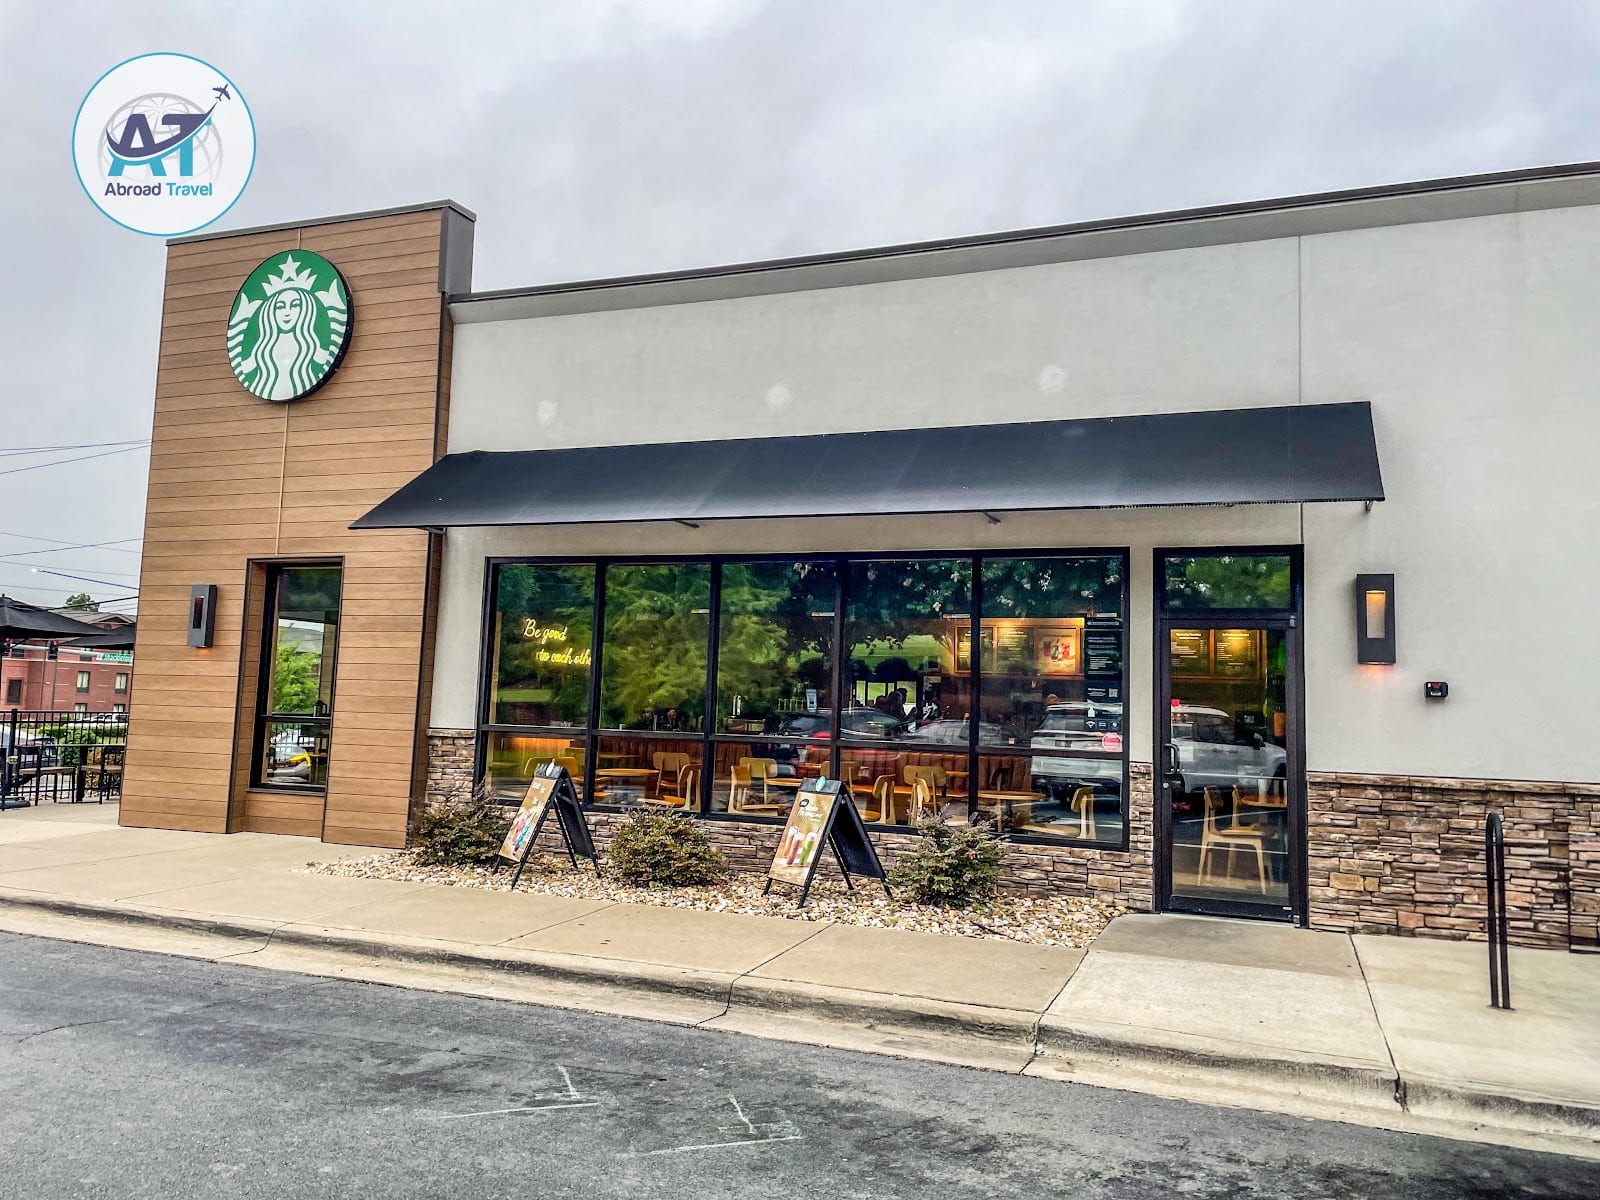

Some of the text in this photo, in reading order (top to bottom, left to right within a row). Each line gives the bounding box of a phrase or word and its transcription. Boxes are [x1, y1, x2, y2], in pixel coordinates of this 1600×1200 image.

[524, 618, 568, 645] Be good
[537, 647, 592, 666] to each oth
